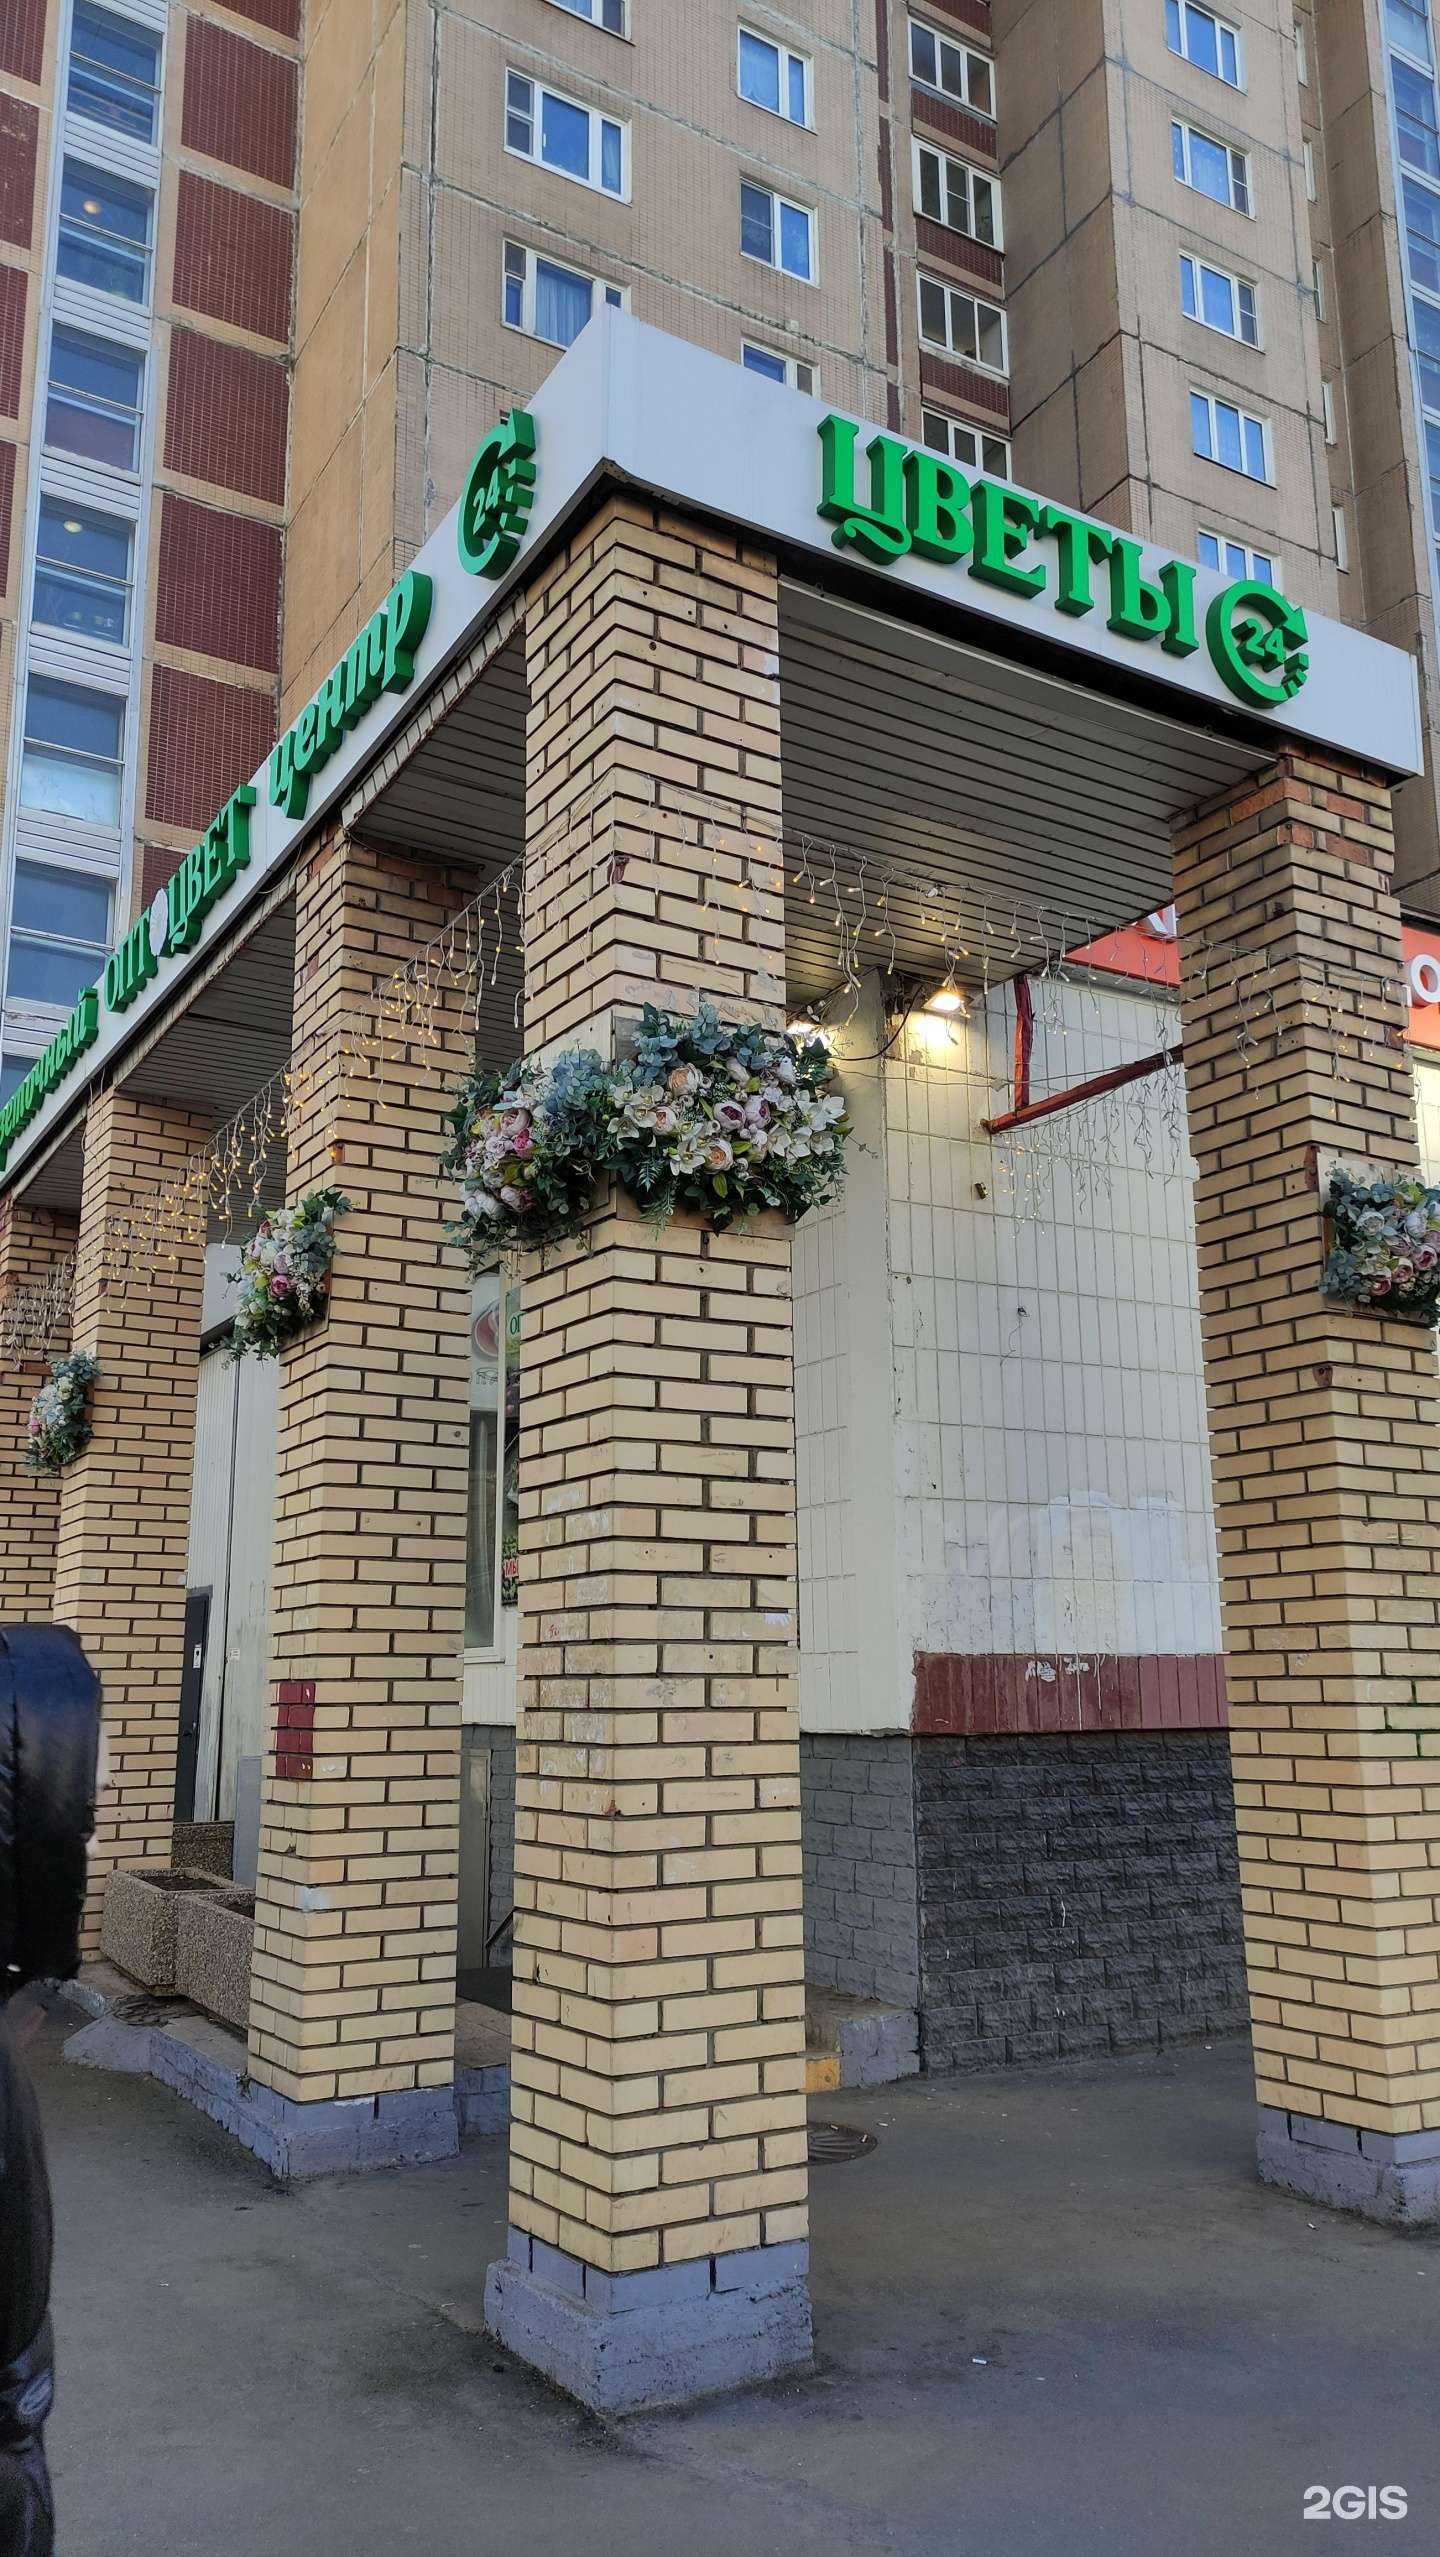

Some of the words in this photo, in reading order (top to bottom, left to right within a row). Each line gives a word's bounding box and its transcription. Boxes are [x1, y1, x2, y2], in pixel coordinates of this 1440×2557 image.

[268, 570, 433, 821] центр
[473, 466, 503, 536] 24
[817, 414, 1199, 658] ЦВЕТЫ
[1234, 617, 1287, 668] 24
